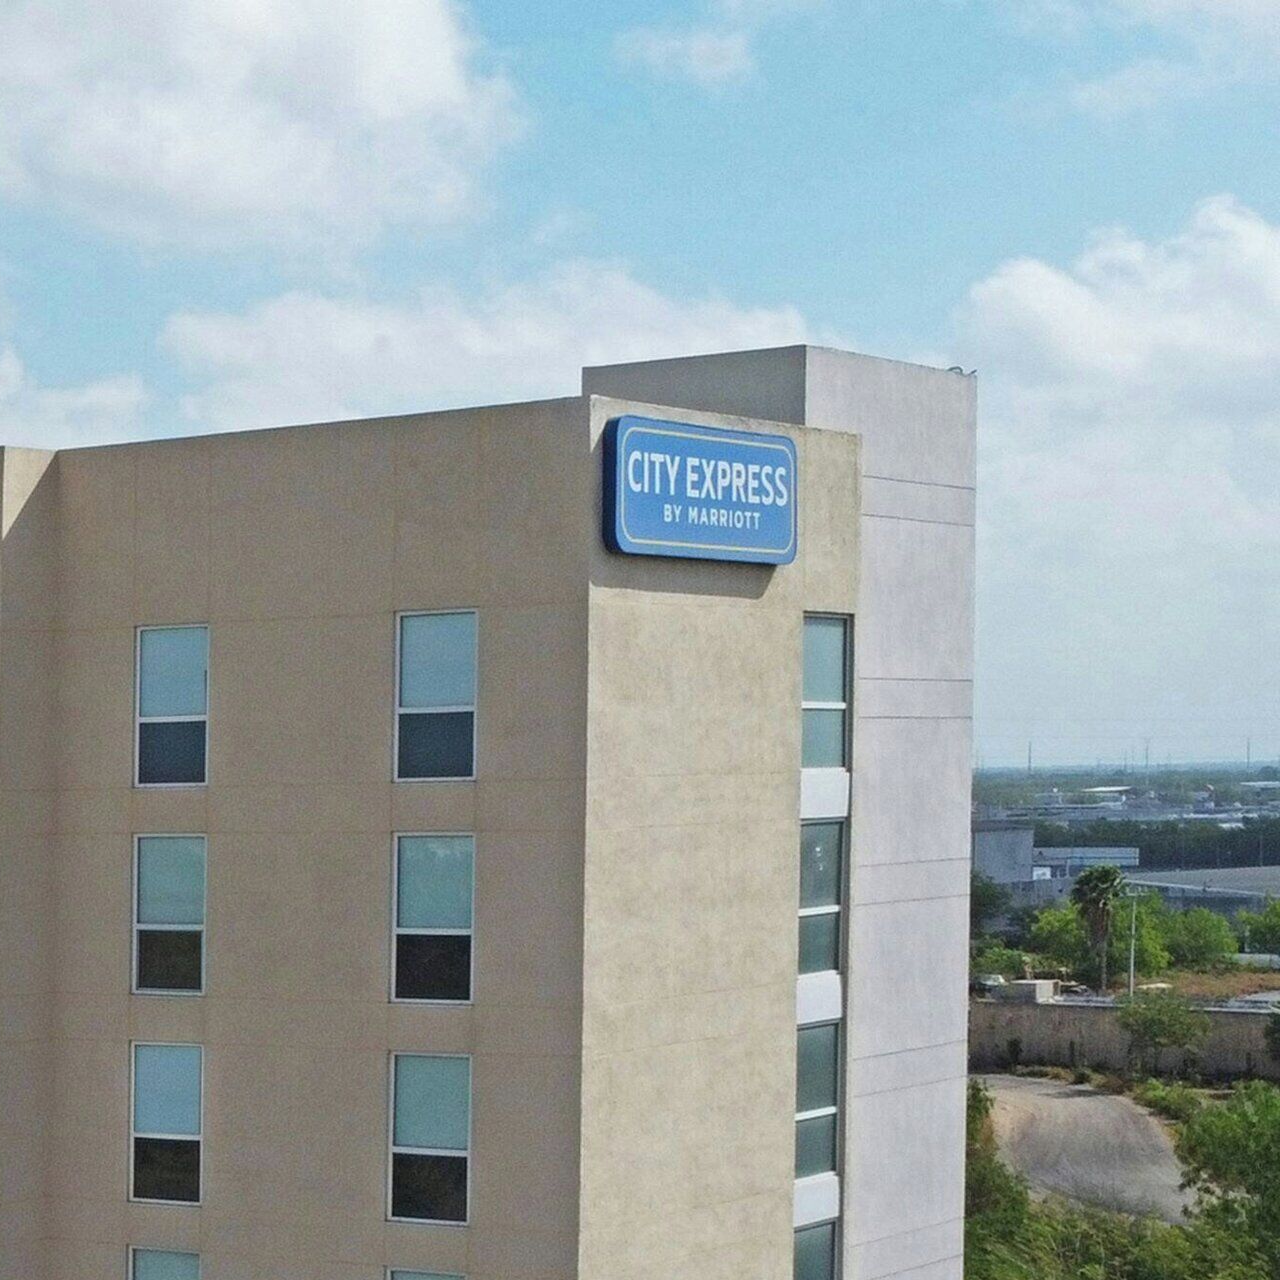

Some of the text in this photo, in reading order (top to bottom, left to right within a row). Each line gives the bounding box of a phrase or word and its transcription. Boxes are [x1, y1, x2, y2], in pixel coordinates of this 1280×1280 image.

[627, 450, 788, 507] CITY EXPRESS
[663, 504, 761, 530] BY MARRIOTT
